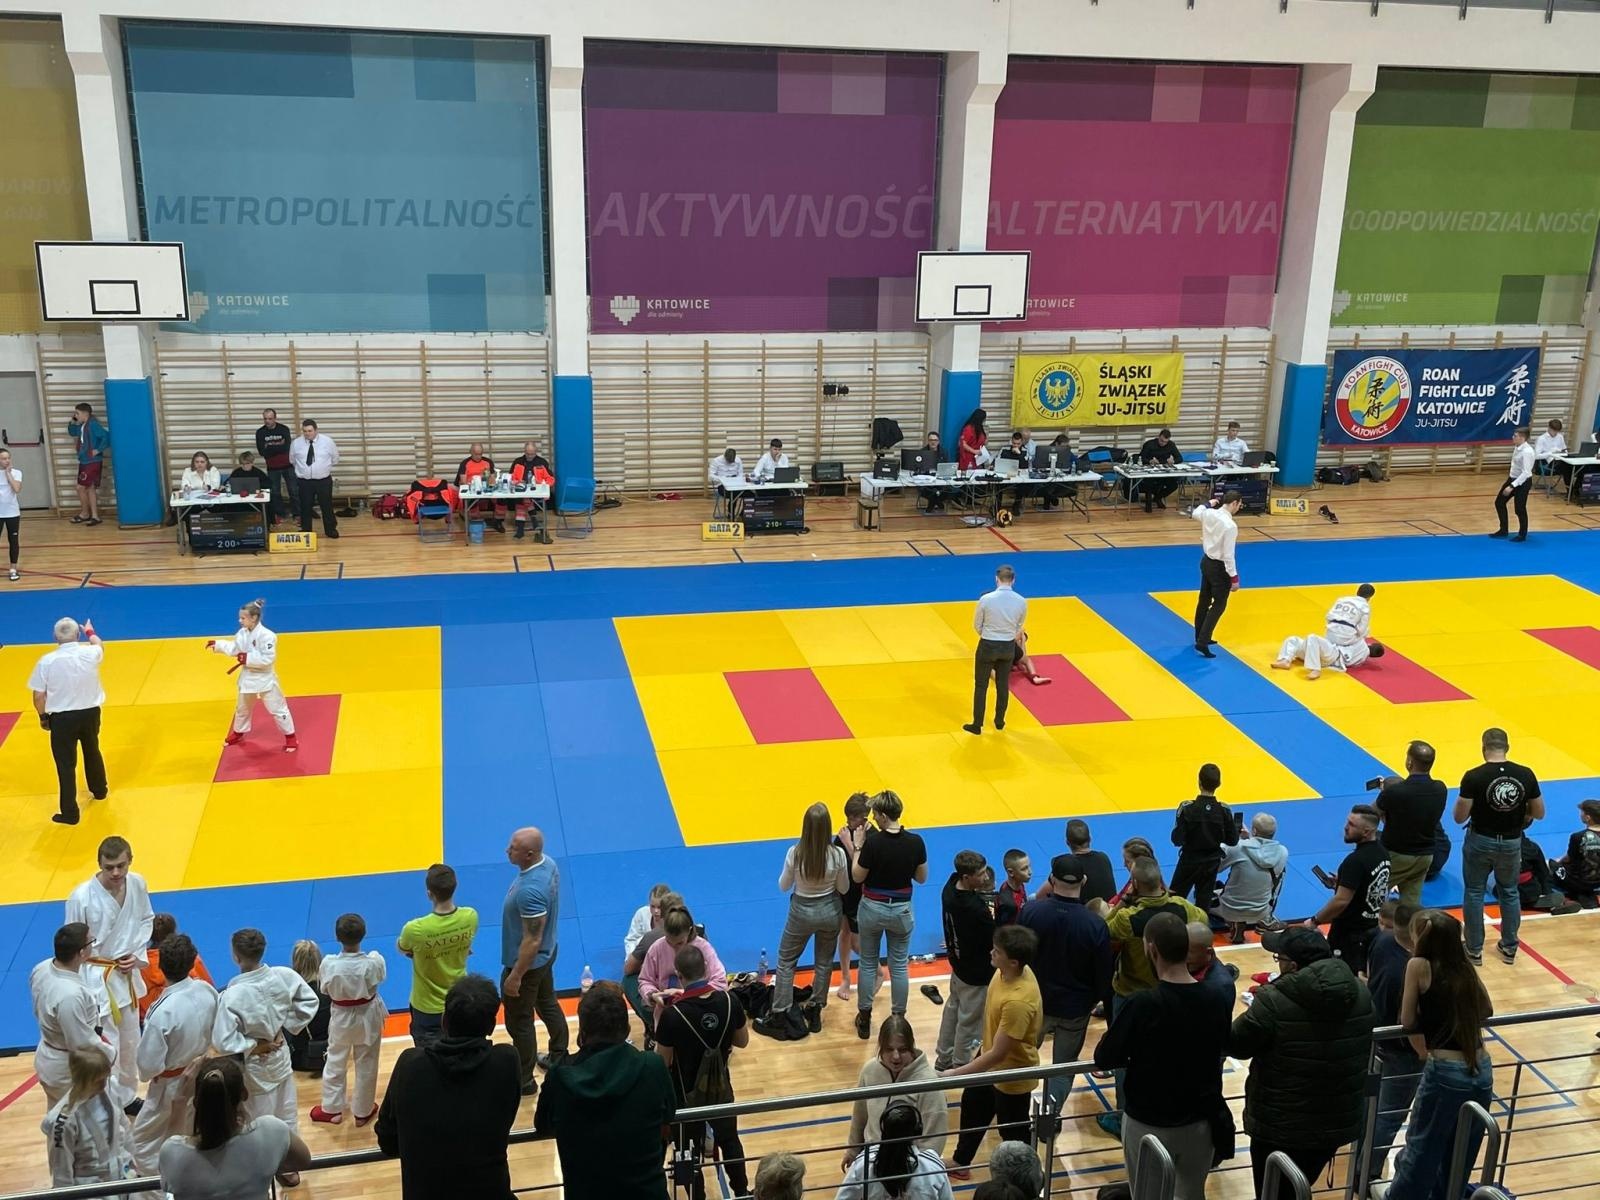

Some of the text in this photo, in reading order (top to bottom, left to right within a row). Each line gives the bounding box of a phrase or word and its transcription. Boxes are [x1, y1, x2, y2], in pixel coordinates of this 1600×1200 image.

[154, 194, 537, 229] METROPOLITALNOŚĆ
[593, 183, 934, 239] AKTYWNOŚĆ
[1346, 208, 1595, 234] OODPOWIEDZIALNOŚĆ
[216, 295, 290, 306] KATOWICE
[646, 299, 711, 309] KATOWICE
[1027, 298, 1076, 308] ATOWICE
[1356, 293, 1409, 303] KATOWICE
[1099, 362, 1152, 383] ŚLĄSKI
[1344, 360, 1408, 390] ROAN FIGHT CLUB
[1422, 368, 1461, 381] ROAN
[1098, 383, 1167, 401] ZWIĄZEK
[1418, 384, 1496, 398] FIGHT CLUB
[1096, 402, 1167, 416] JU-JITSU
[1415, 401, 1487, 415] KATOWICE
[1414, 418, 1459, 428] JU-JITSU
[1350, 424, 1389, 437] KATOWICE
[1298, 500, 1306, 513] 3
[708, 523, 741, 537] MATA 2
[276, 533, 302, 544] MATA
[303, 533, 311, 547] 1
[1335, 603, 1357, 616] POL
[424, 929, 472, 950] SATORI
[54, 1105, 69, 1149] MANT
